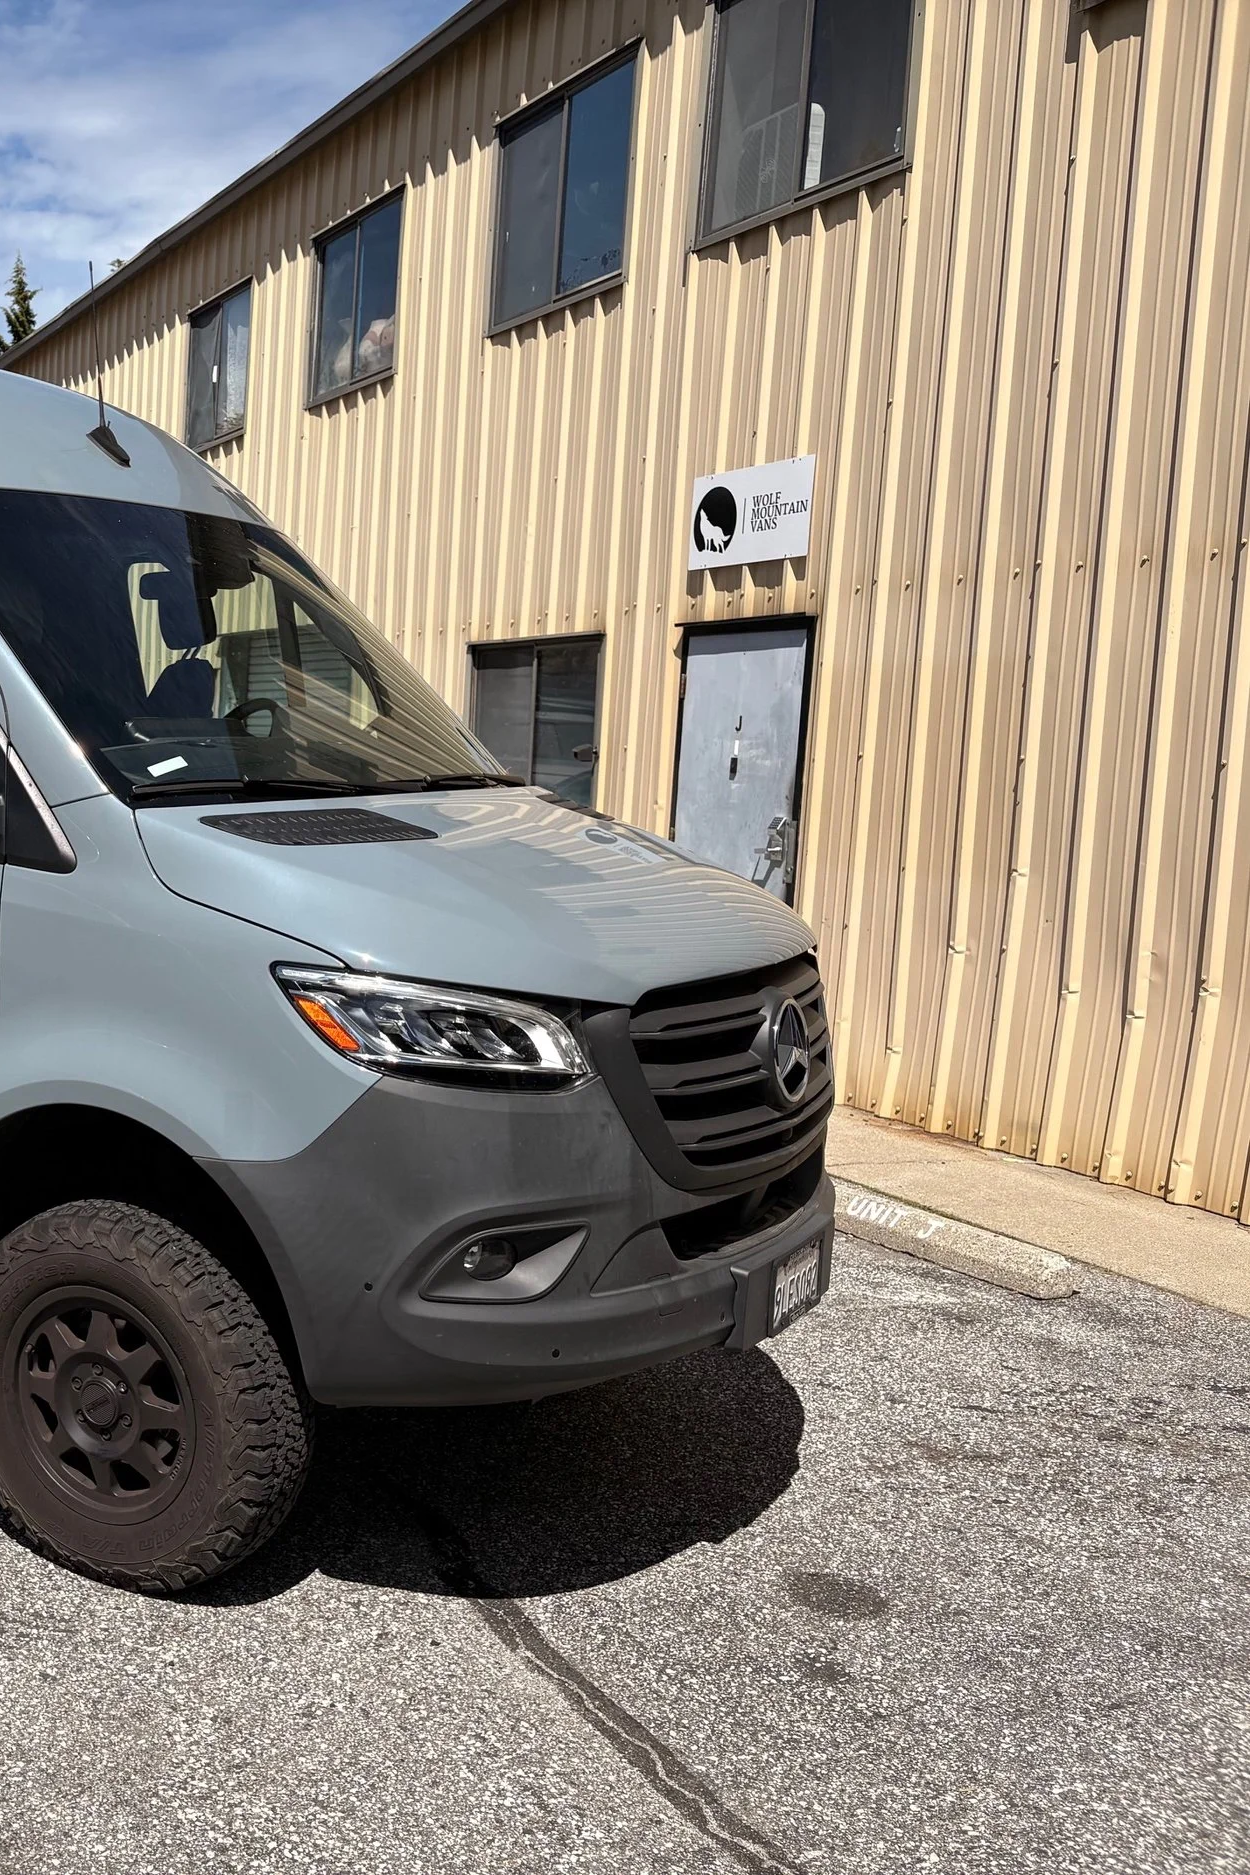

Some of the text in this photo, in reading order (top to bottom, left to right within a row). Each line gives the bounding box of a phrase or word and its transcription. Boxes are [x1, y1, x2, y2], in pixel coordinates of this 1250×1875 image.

[752, 491, 782, 508] WOLF
[750, 499, 809, 521] MOUNTAIN
[750, 517, 778, 533] VANS
[734, 715, 742, 731] J
[846, 1195, 946, 1240] UNIT J
